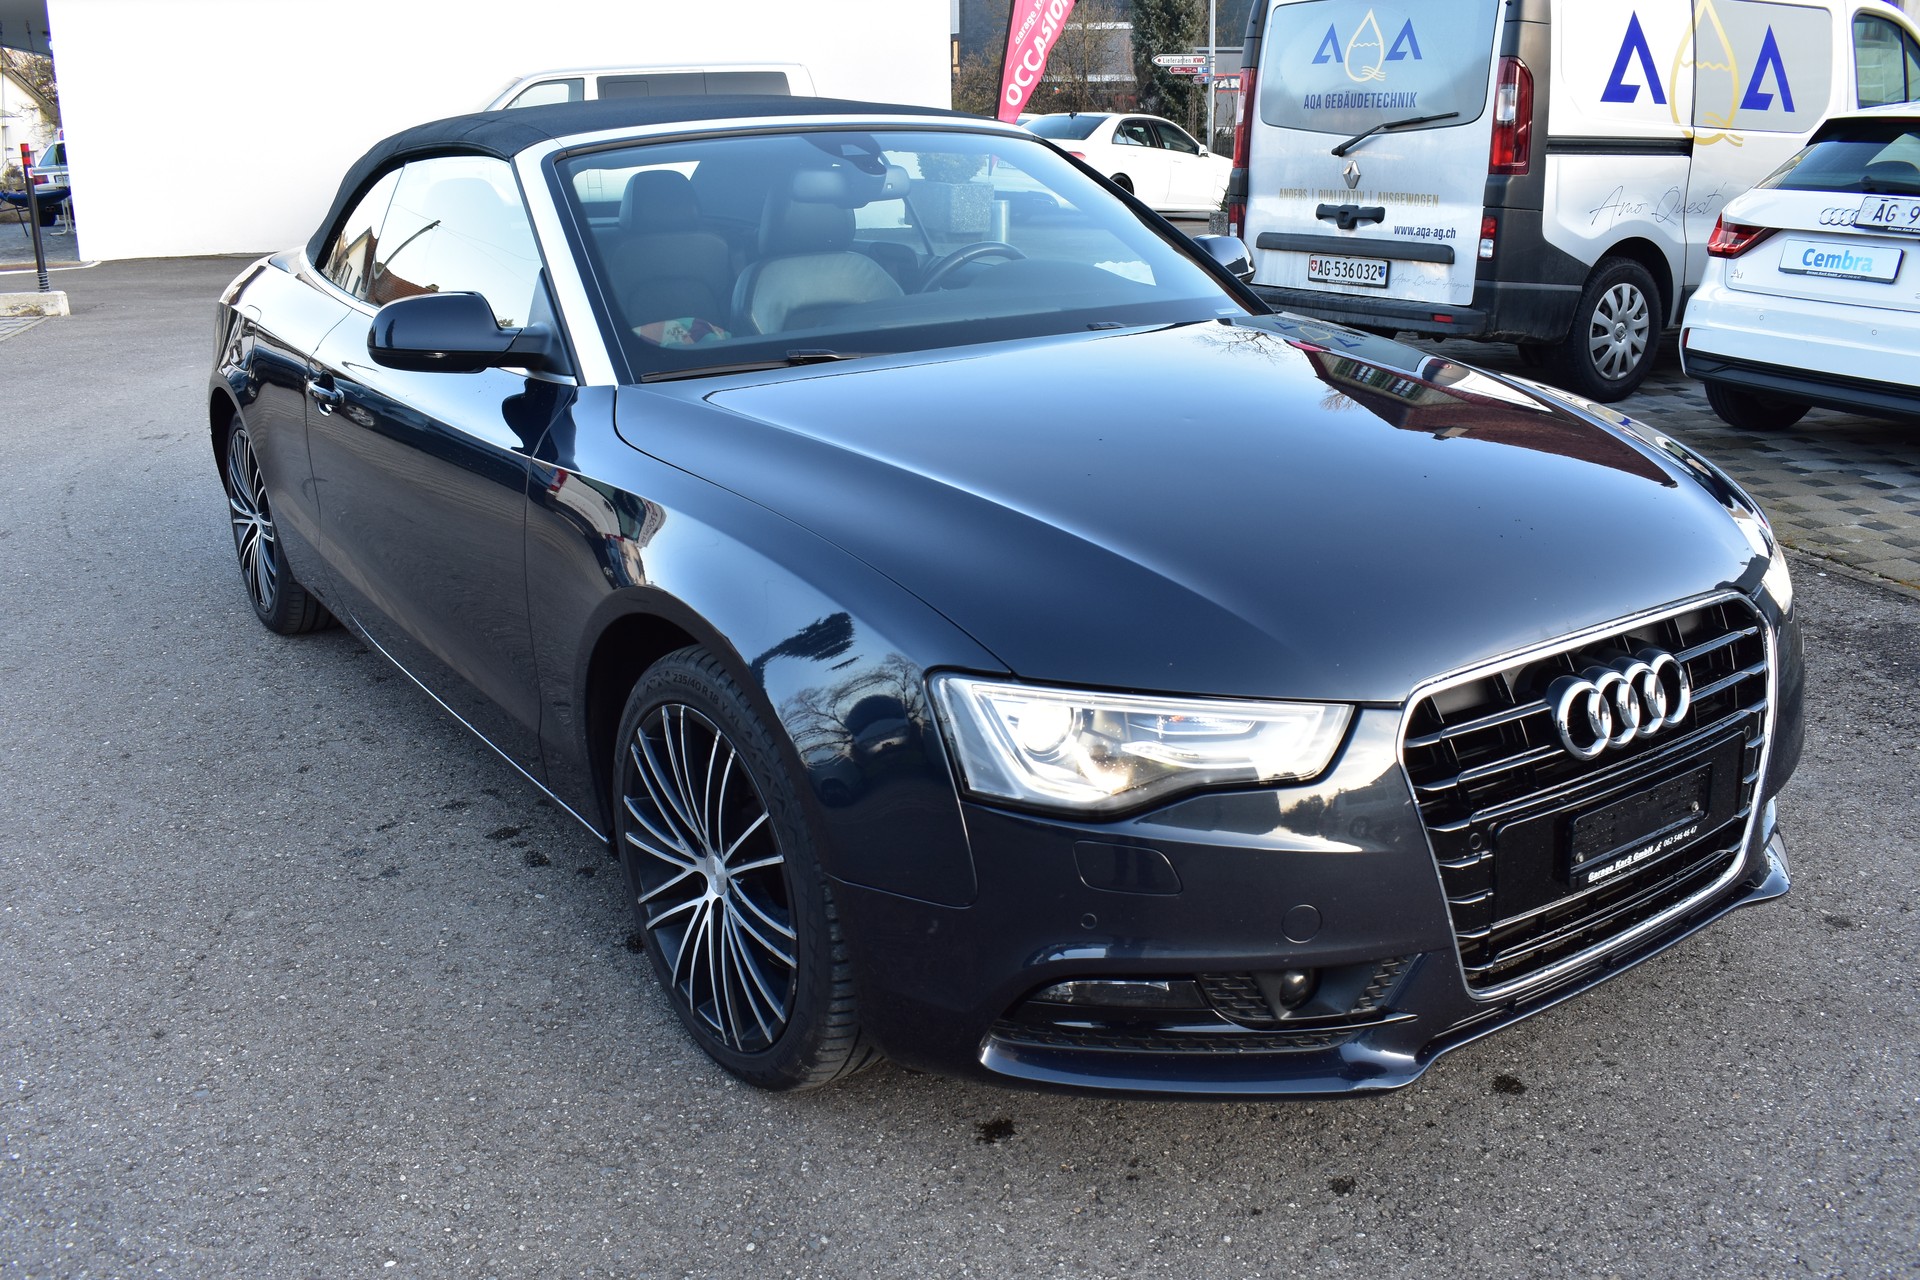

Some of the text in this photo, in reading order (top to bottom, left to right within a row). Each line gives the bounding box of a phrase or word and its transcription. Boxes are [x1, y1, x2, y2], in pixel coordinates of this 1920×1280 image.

[1303, 91, 1417, 109] AQA GEBÄUDETECHNIK
[1279, 188, 1439, 208] ANDERS QUALITATIV AUSGEWOGEN
[1394, 225, 1456, 241] www.aqa-ag.ch
[1802, 248, 1873, 272] Cembra
[672, 673, 701, 692] 235/40
[1588, 865, 1614, 881] Garage
